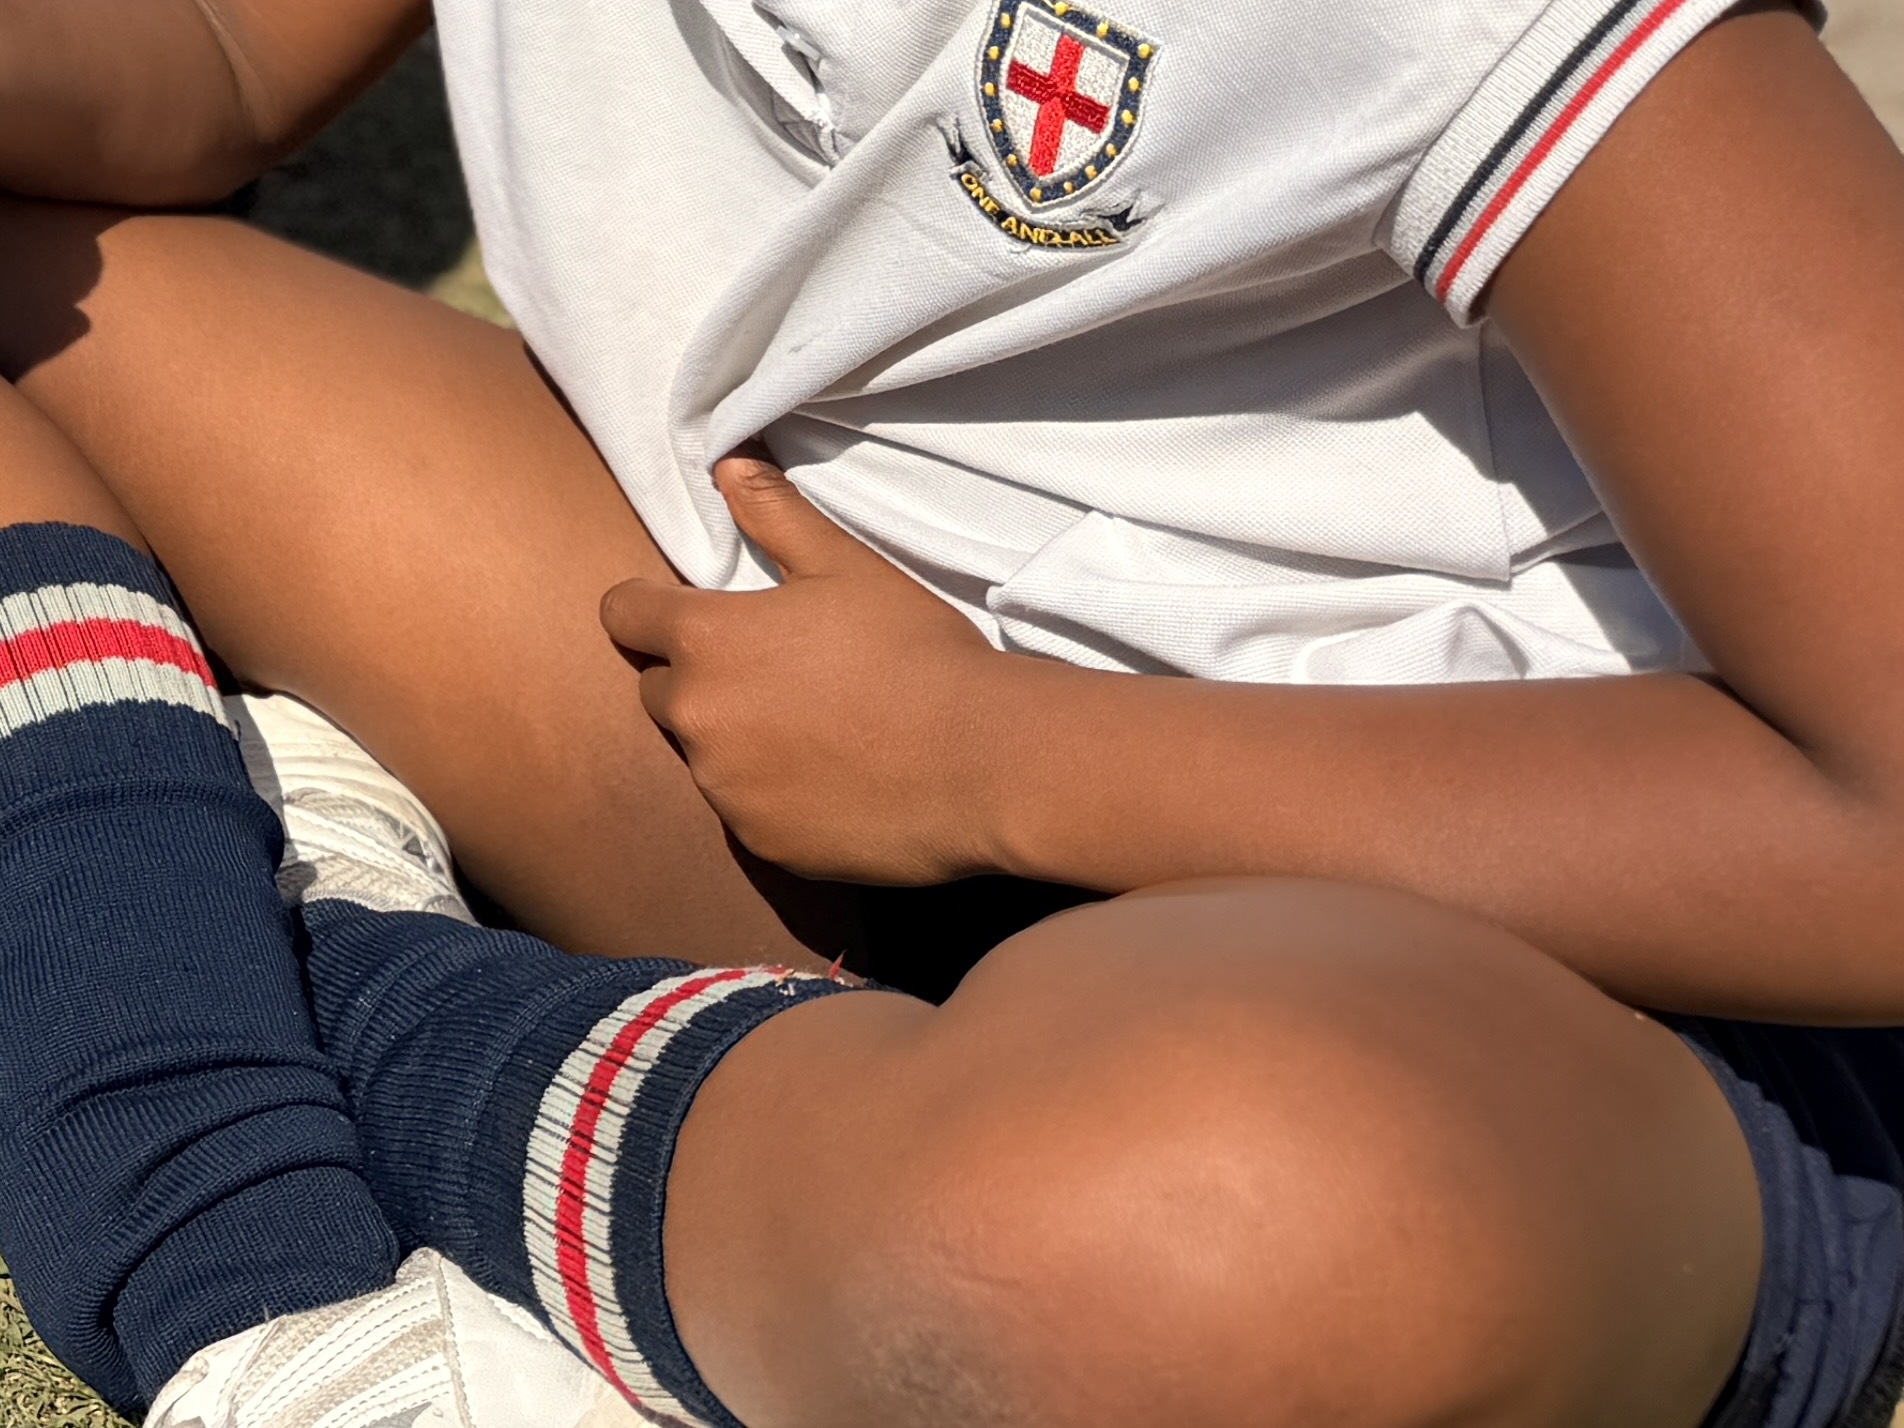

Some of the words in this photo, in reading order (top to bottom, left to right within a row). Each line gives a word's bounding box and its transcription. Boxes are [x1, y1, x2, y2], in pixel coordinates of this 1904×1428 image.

[961, 173, 999, 216] ONE
[1001, 216, 1062, 247] AND
[1068, 229, 1119, 247] ALL
